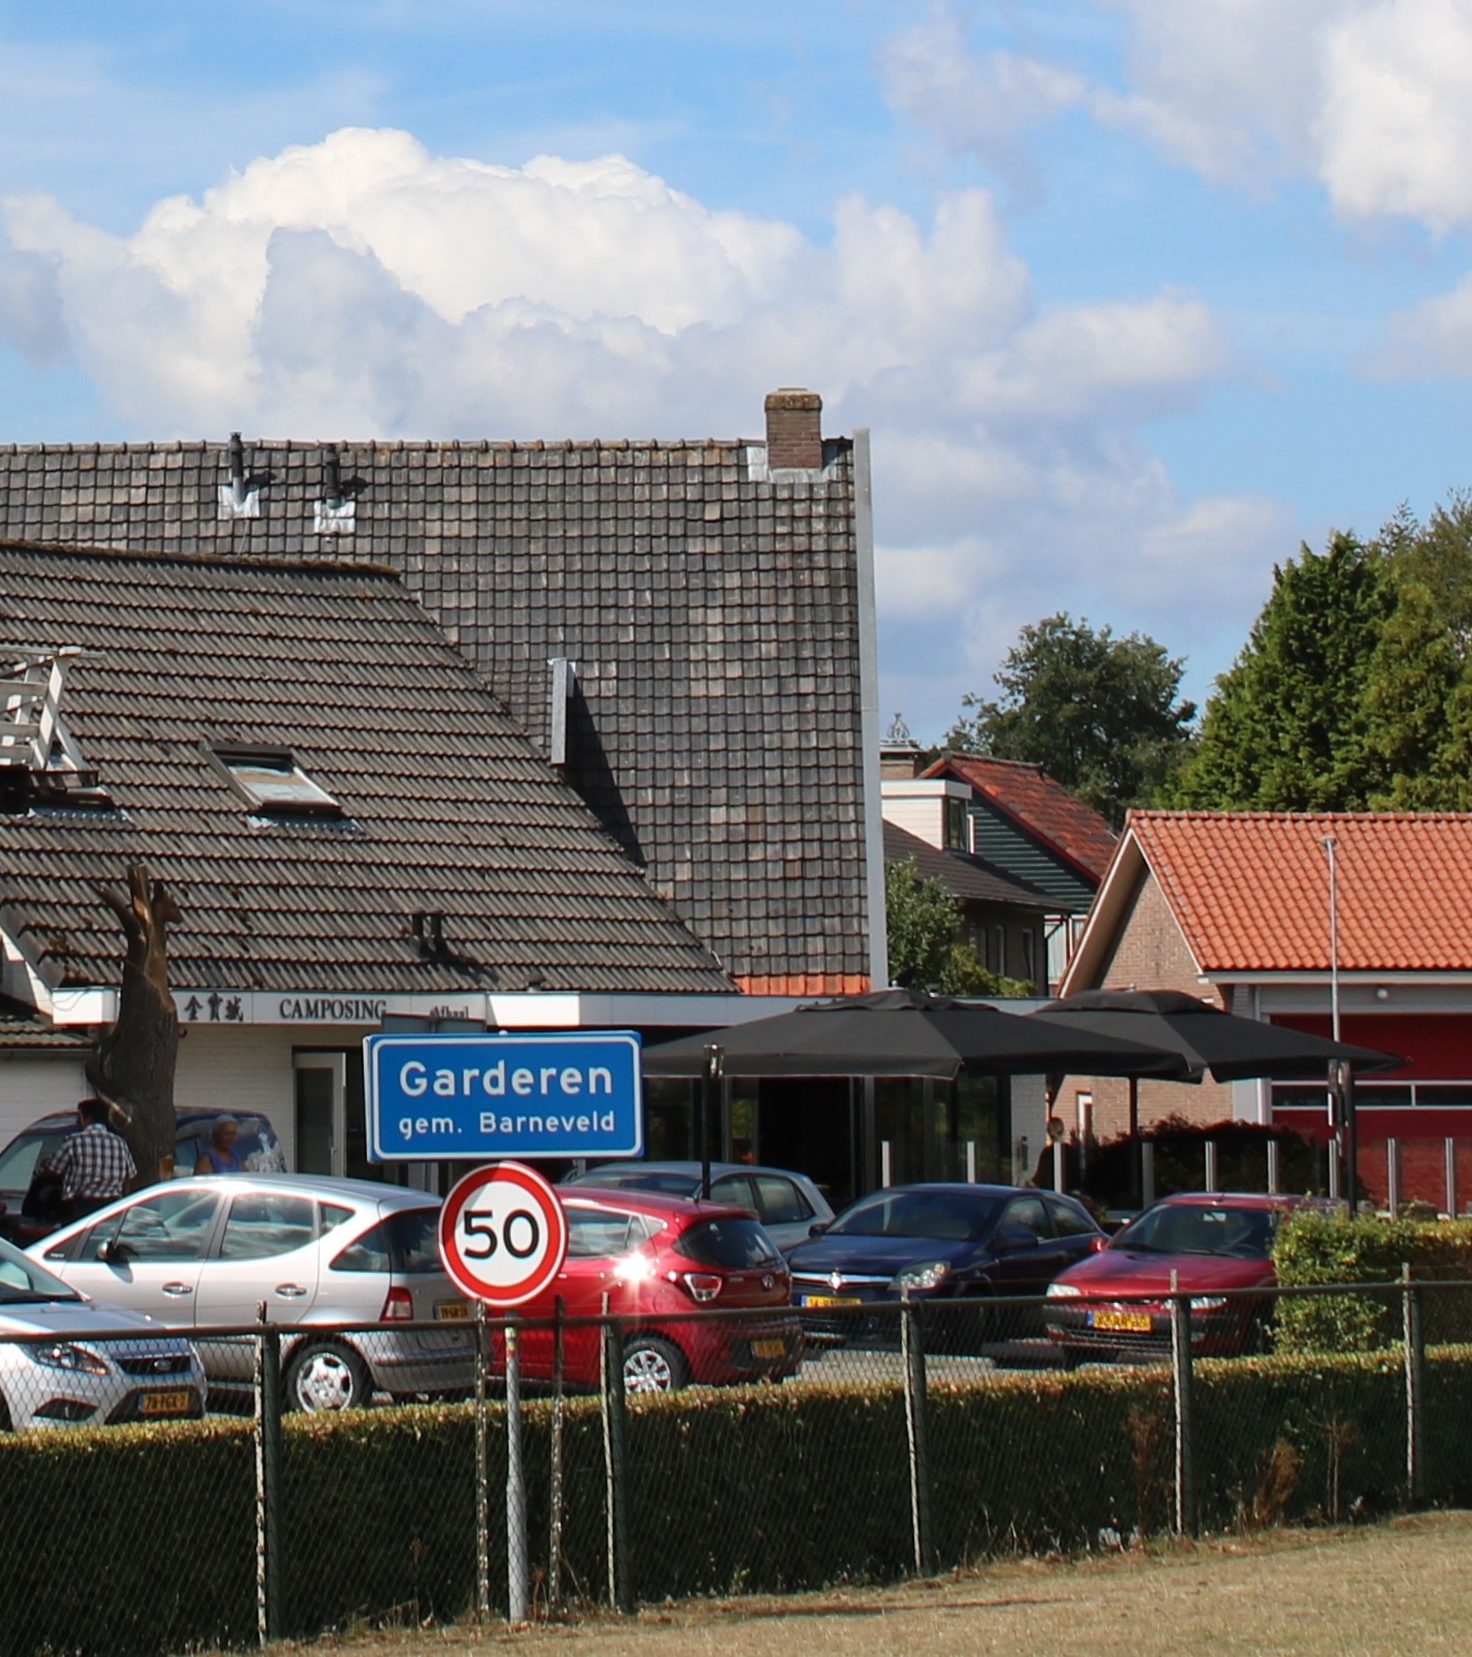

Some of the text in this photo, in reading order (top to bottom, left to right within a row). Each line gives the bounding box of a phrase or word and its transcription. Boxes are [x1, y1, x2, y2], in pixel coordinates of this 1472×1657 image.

[280, 999, 387, 1019] CAMPOSING
[399, 1059, 613, 1097] Garderen
[398, 1110, 615, 1141] gem. Barneveld
[463, 1208, 540, 1260] 50
